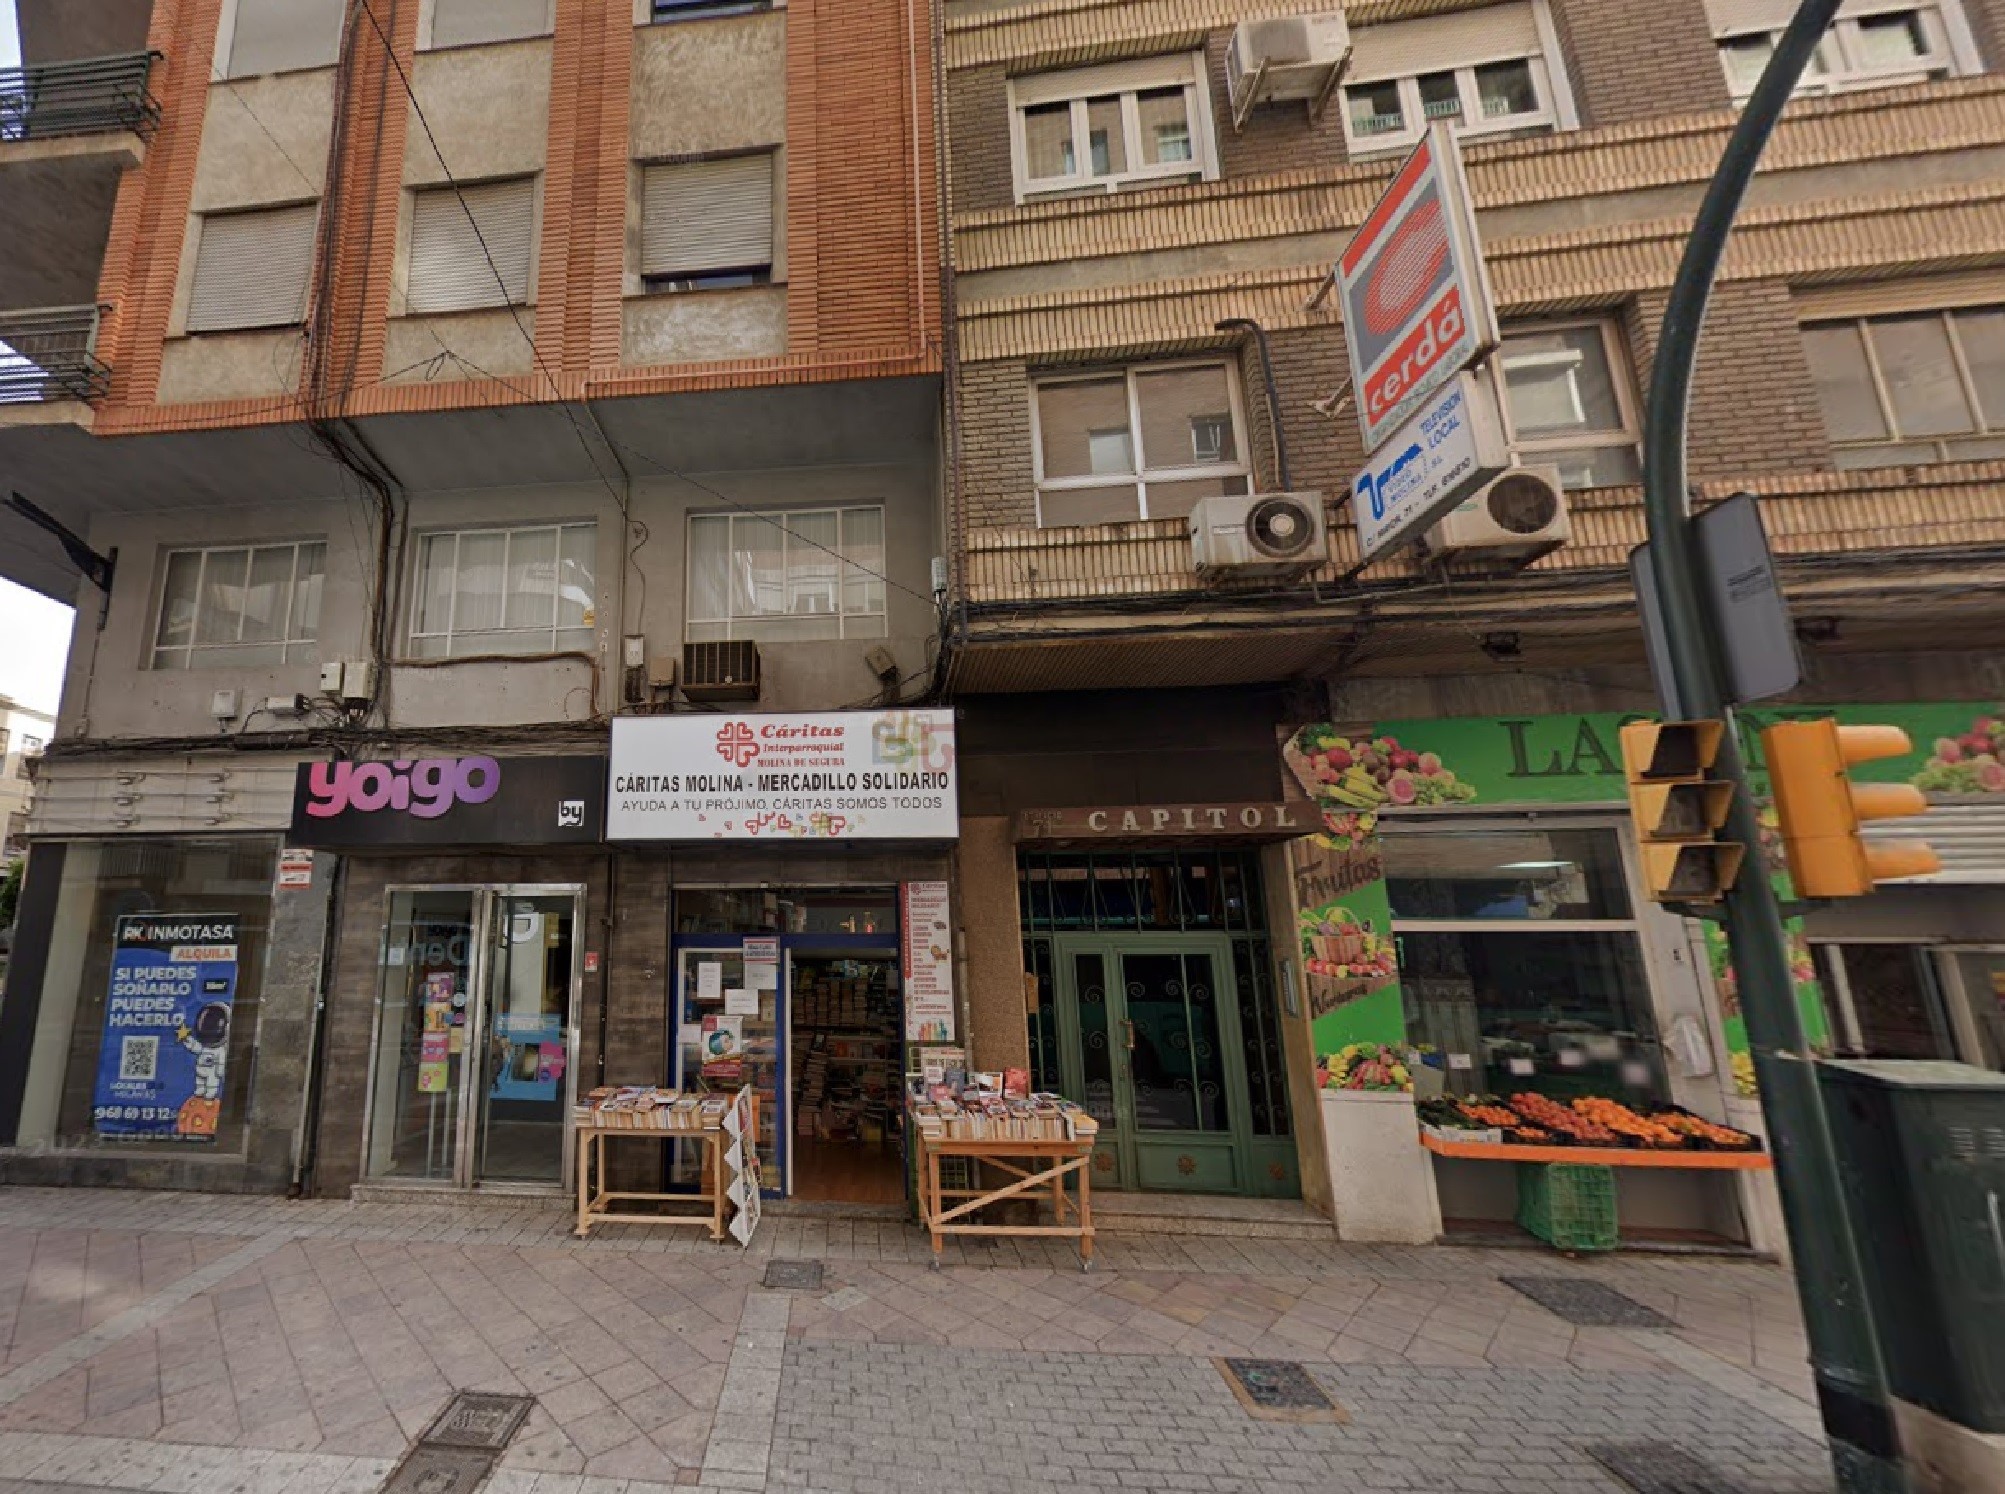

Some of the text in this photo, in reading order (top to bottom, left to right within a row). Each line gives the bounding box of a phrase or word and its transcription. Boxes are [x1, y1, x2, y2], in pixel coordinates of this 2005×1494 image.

[1371, 301, 1460, 413] cerdá
[1428, 416, 1461, 449] LOCAL
[760, 723, 845, 738] Cáritas
[763, 743, 845, 754] Interparroquial
[757, 757, 845, 768] MOLINA DE SEGURA
[306, 756, 500, 818] yoigo
[616, 772, 679, 792] CÁRITAS
[685, 774, 743, 792] MOLINA
[757, 771, 858, 792] MERCADILLO
[862, 771, 949, 790] SOLIDARIO
[622, 799, 667, 811] AYUDA
[670, 799, 680, 811] A
[684, 799, 700, 811] TU
[772, 796, 832, 810] CÁRITAS
[836, 797, 887, 810] SOMOS
[892, 796, 943, 809] TODOS
[561, 800, 582, 825] by
[1088, 805, 1297, 832] CAPITOL
[1295, 855, 1381, 907] Frutas
[149, 925, 235, 940] INMOTASA
[177, 948, 232, 961] ALQUILA
[115, 966, 197, 981] SI PUEDES
[112, 979, 192, 996] SOÑARLO
[111, 997, 174, 1011] PUEDES
[109, 1013, 185, 1027] HACERLO
